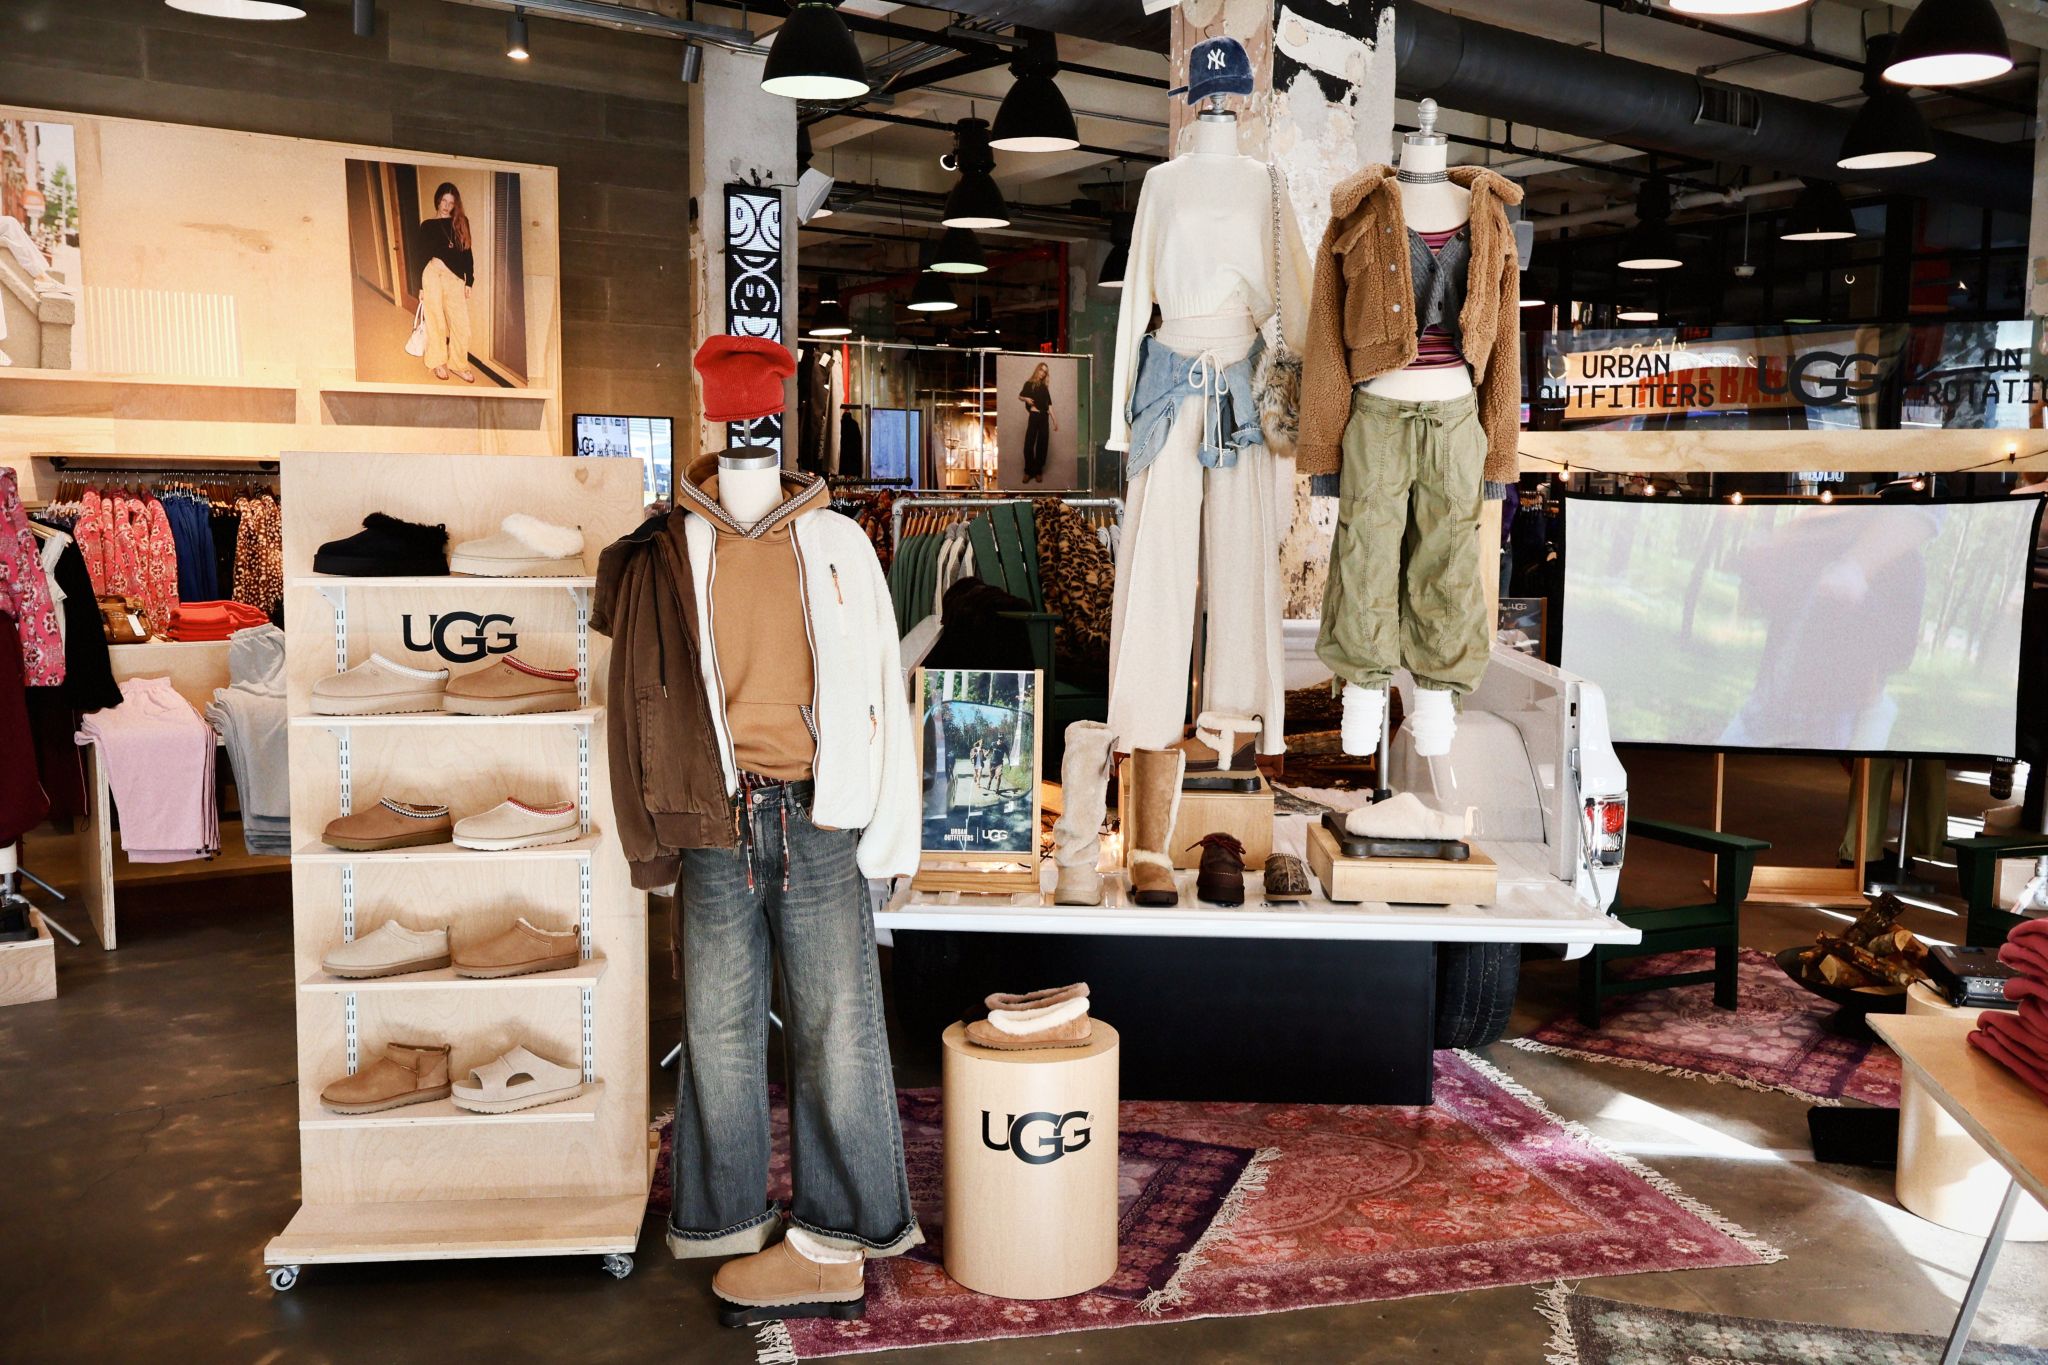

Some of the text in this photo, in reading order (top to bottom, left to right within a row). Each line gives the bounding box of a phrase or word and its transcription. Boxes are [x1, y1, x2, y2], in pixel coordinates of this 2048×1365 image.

[1207, 48, 1226, 70] NY
[1582, 353, 1670, 379] URBAN
[1985, 348, 2022, 373] ON
[1757, 350, 1883, 407] UGG
[1538, 384, 1715, 410] OUTFITTERS
[401, 611, 518, 664] UGG
[982, 829, 1009, 842] UGG
[981, 1110, 1091, 1165] UGG
